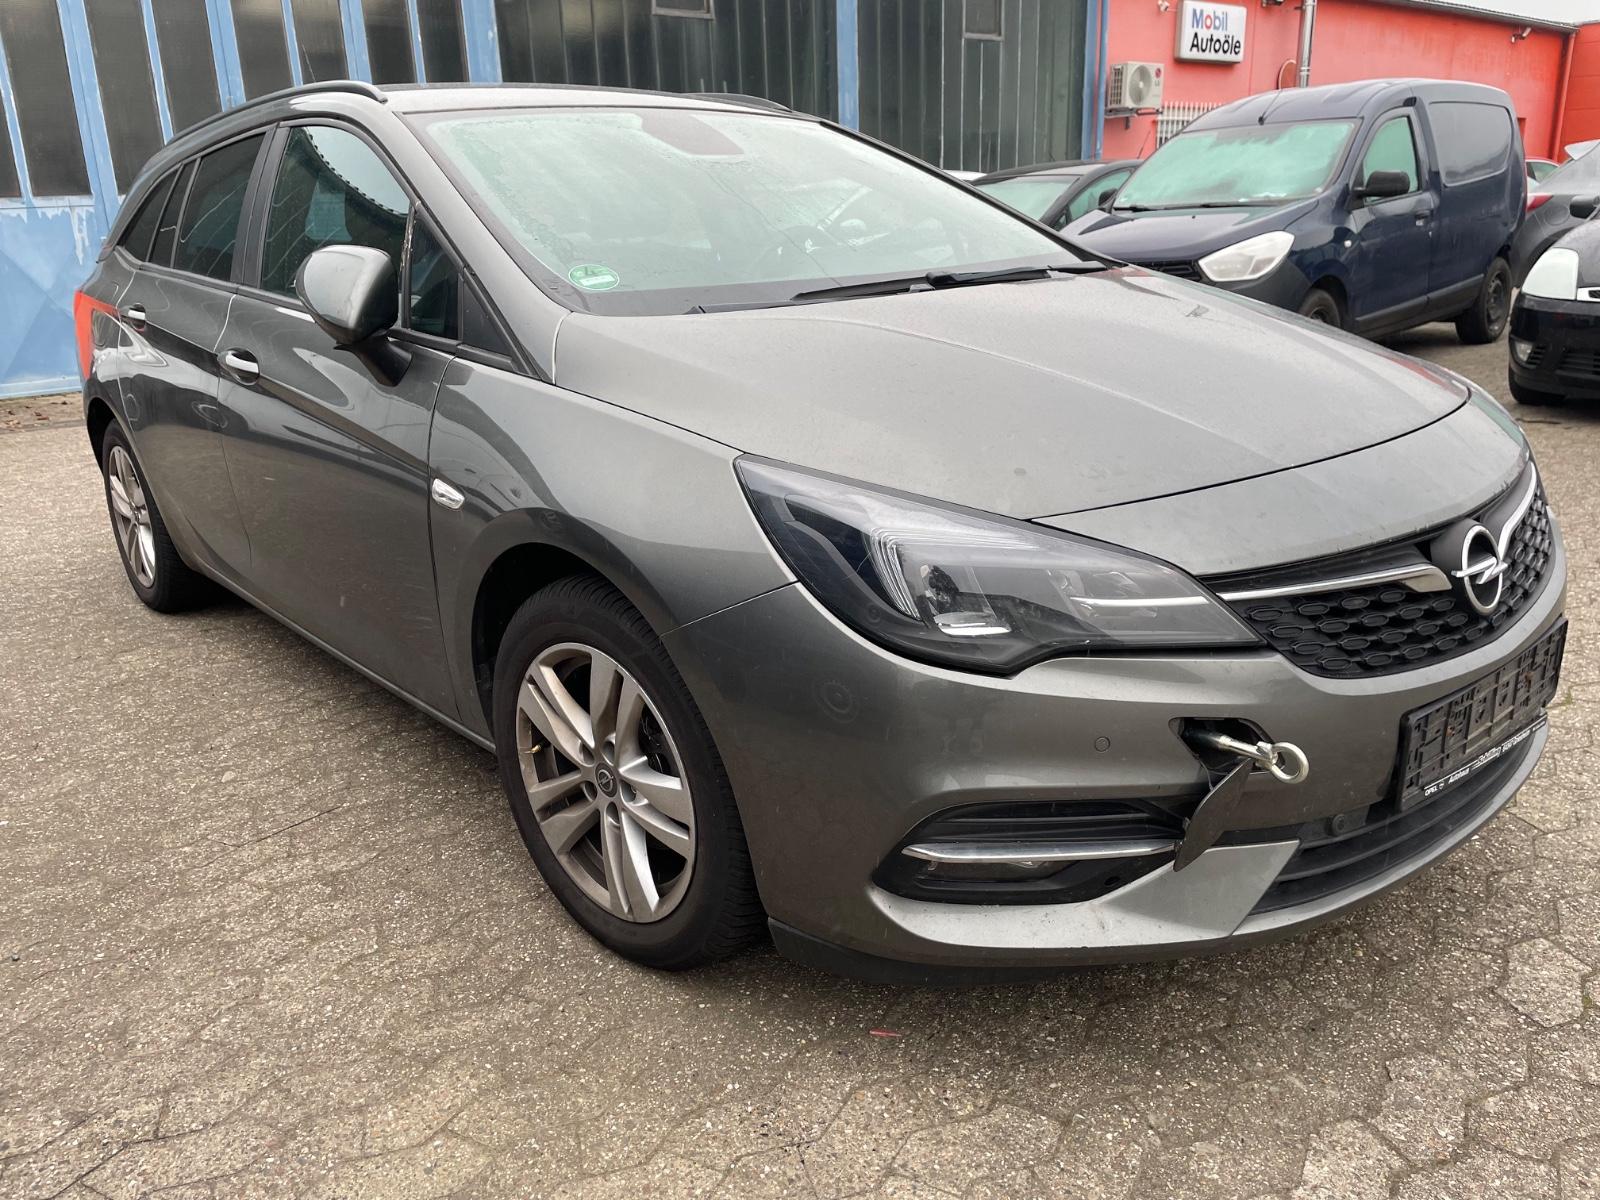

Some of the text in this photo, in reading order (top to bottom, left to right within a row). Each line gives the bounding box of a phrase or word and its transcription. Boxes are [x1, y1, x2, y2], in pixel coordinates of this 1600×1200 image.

[1191, 8, 1228, 31] Mobil
[1190, 32, 1241, 55] Autoöle
[1424, 786, 1438, 797] OPEL
